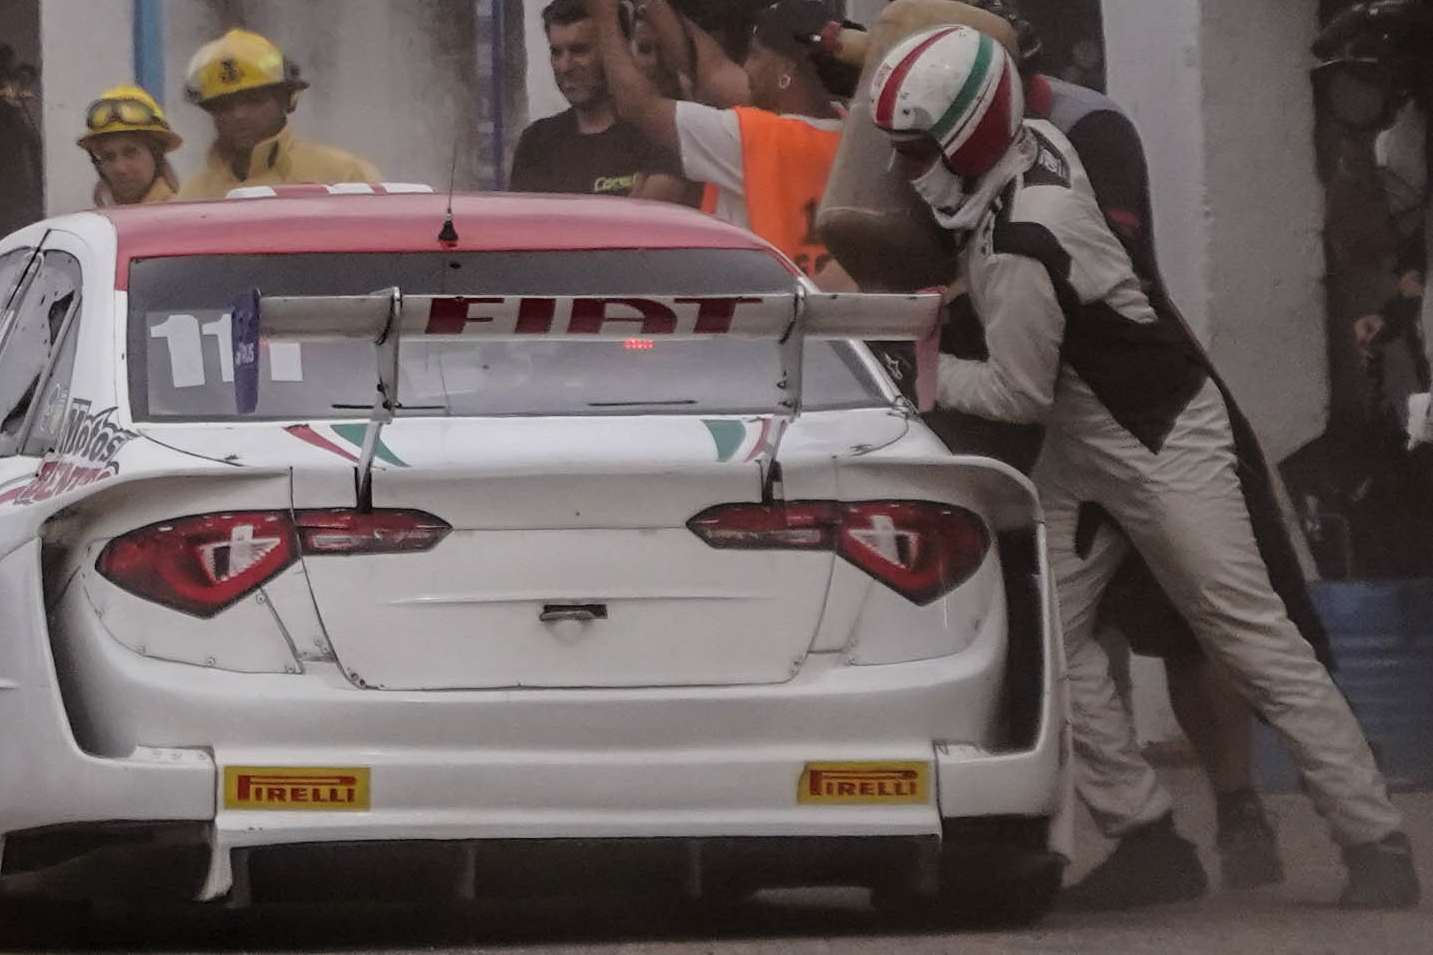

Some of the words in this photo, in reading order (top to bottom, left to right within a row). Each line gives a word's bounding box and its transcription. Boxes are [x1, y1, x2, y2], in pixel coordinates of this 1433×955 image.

[424, 297, 763, 335] FIAT
[237, 775, 357, 802] PIRELLI
[808, 770, 918, 796] PIRELLI
